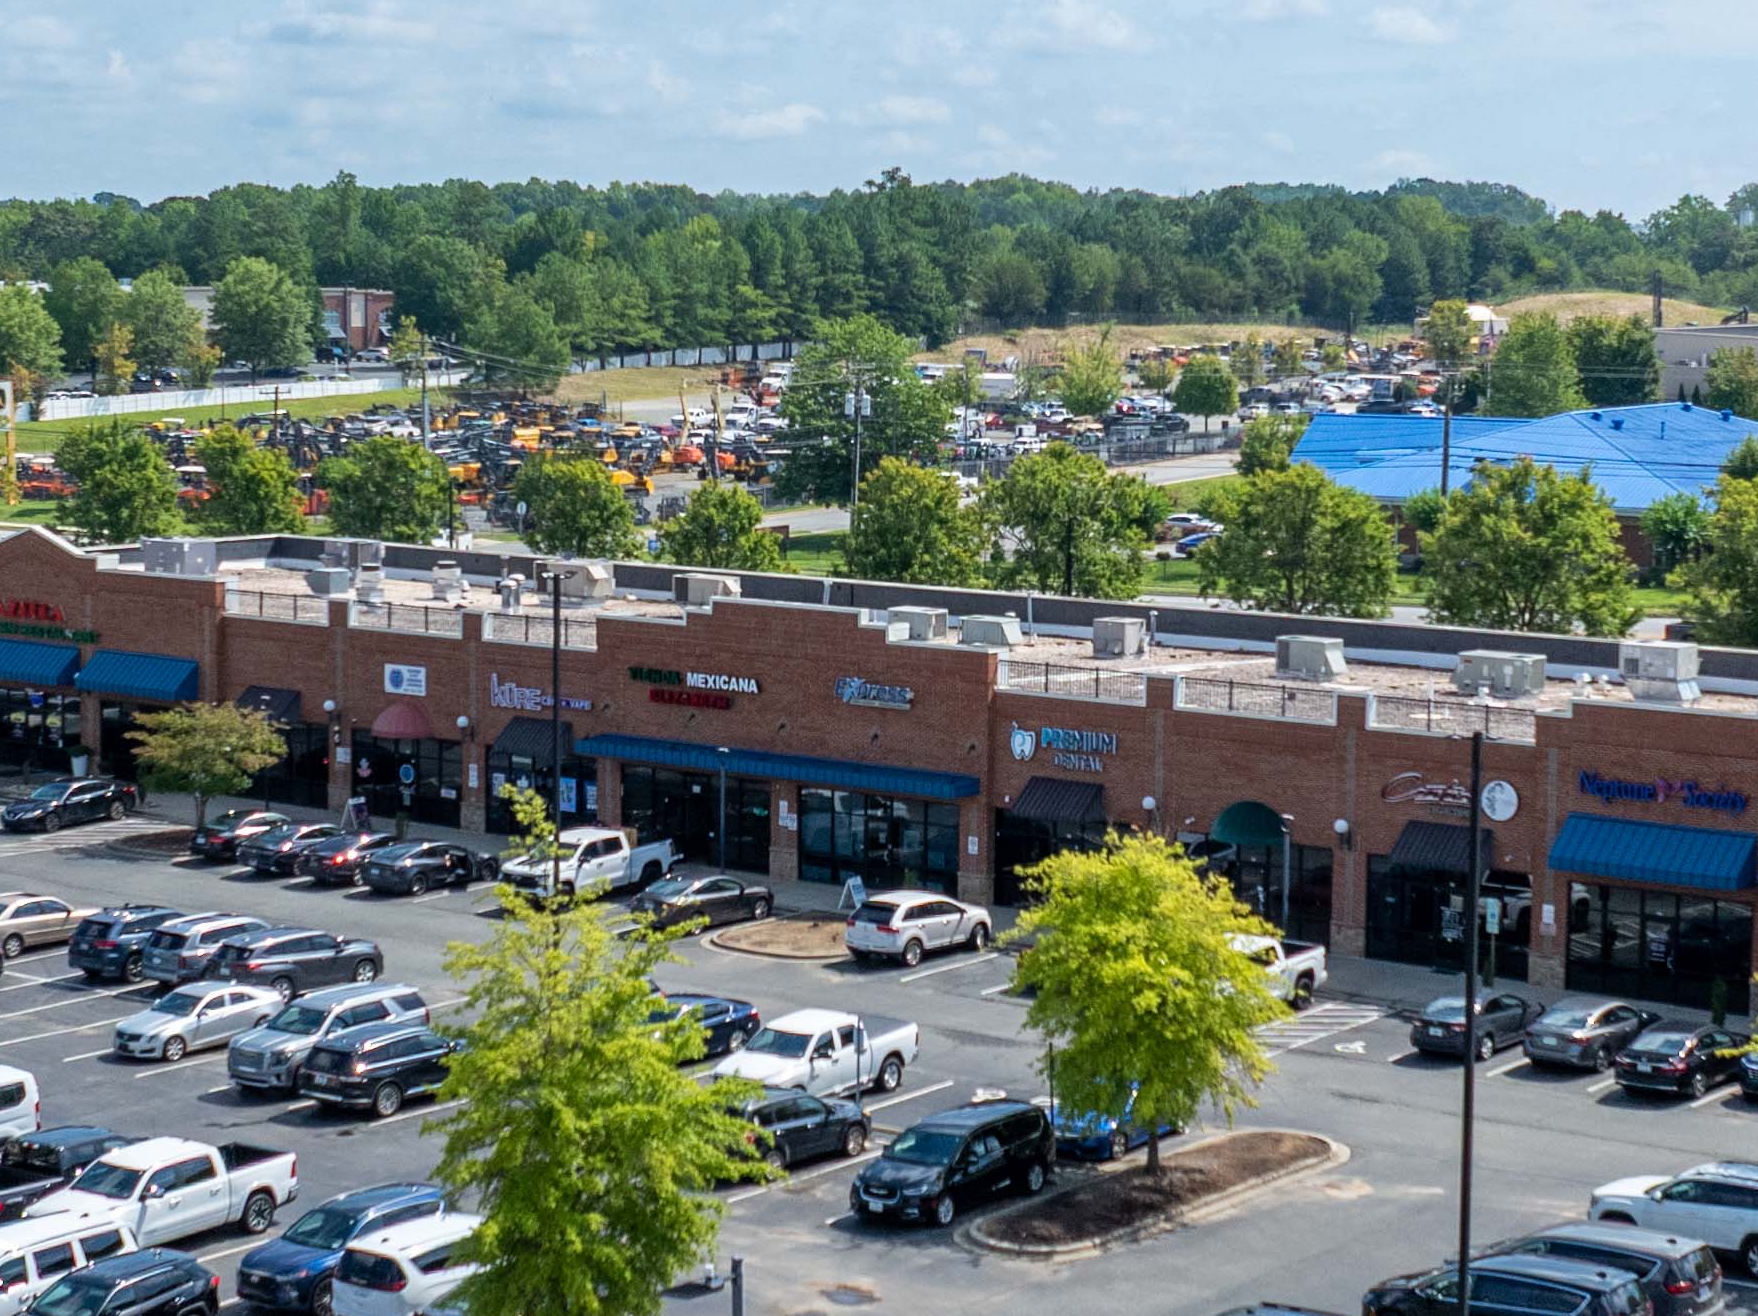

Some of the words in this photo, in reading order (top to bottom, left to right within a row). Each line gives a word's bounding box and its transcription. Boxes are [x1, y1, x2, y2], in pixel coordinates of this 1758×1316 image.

[686, 672, 759, 694] MEXICANA
[1041, 726, 1117, 755] PREMIUM
[1054, 753, 1104, 773] DENTAL
[1578, 769, 1655, 803] Neptune
[1683, 780, 1749, 815] Society
